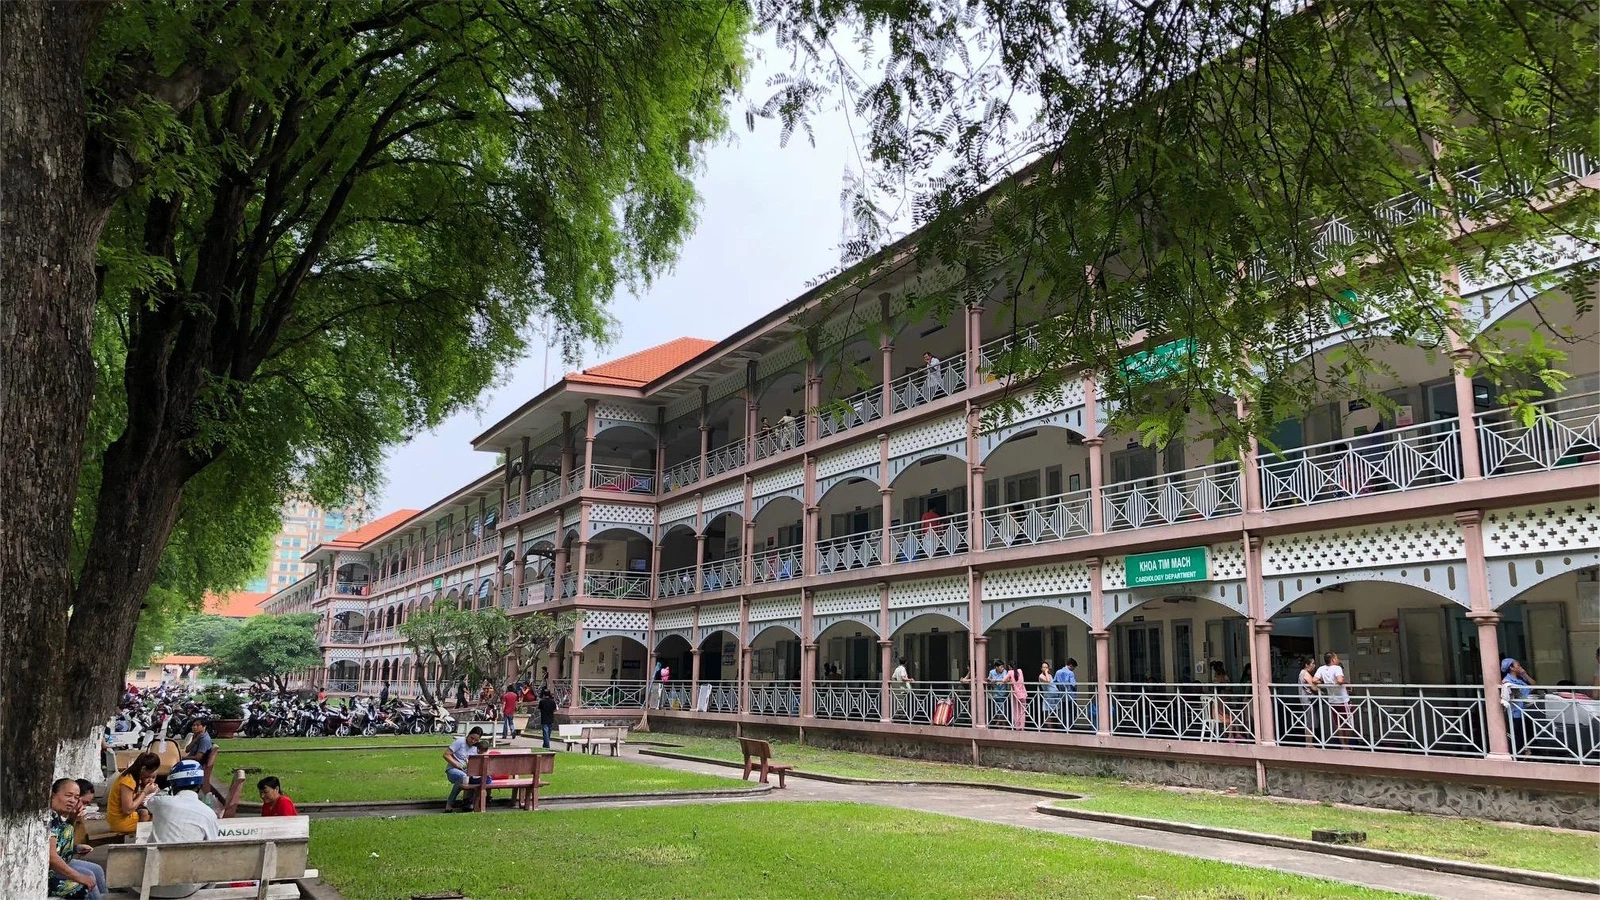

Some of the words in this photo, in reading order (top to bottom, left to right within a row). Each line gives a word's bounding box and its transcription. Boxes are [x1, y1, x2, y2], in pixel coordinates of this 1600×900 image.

[1139, 561, 1157, 572] KHOA
[1158, 558, 1170, 570] TIM
[1171, 556, 1191, 571] MẠCH
[1135, 574, 1164, 583] CARDIOLOGY
[1165, 571, 1197, 580] DEPARTMENT
